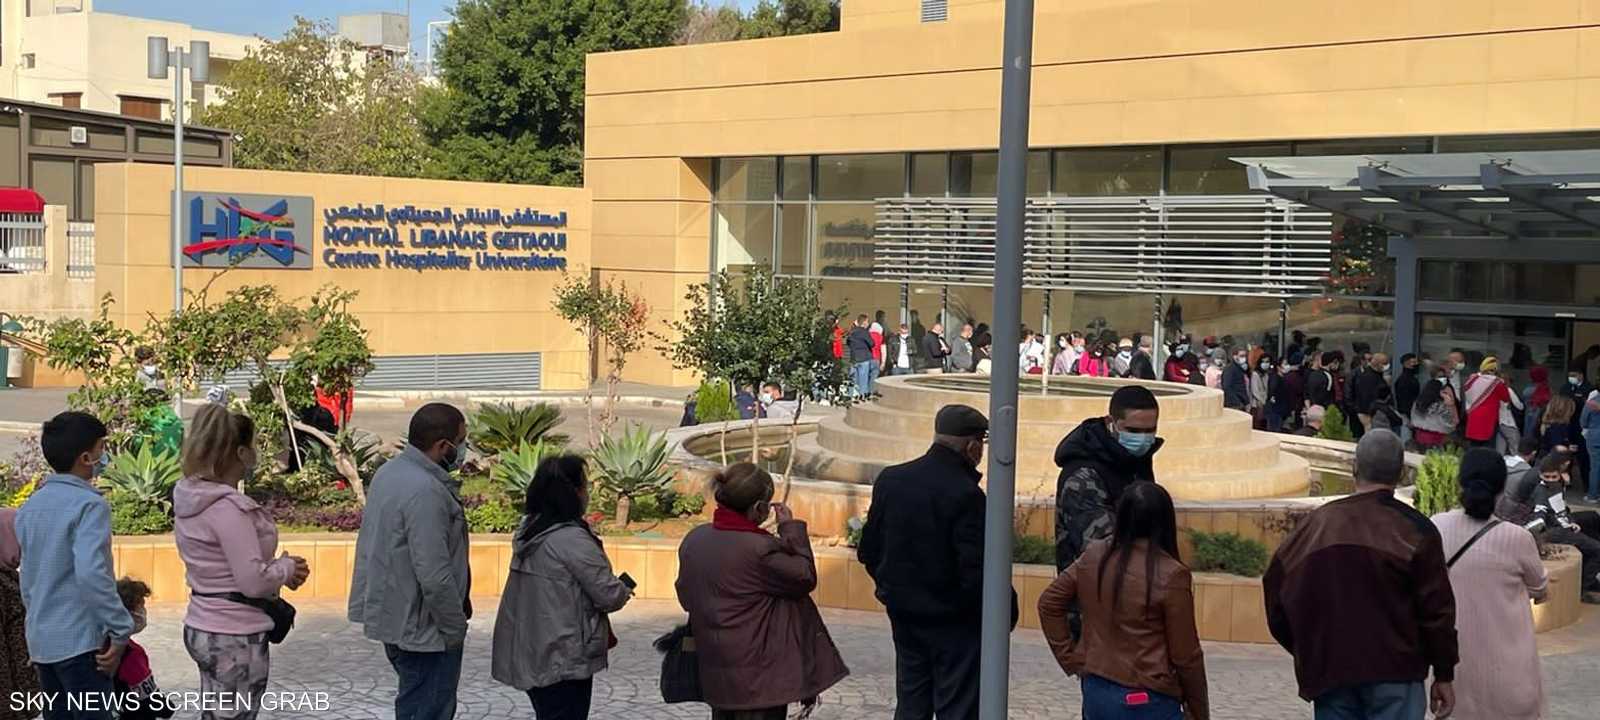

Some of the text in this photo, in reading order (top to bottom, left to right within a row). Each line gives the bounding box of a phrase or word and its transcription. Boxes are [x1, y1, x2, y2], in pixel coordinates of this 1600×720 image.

[452, 207, 501, 231] اللبناني
[323, 226, 404, 248] HOPITAL
[410, 228, 488, 250] LIBANAIS
[323, 248, 567, 273] Centre Hospitalier Universitaire
